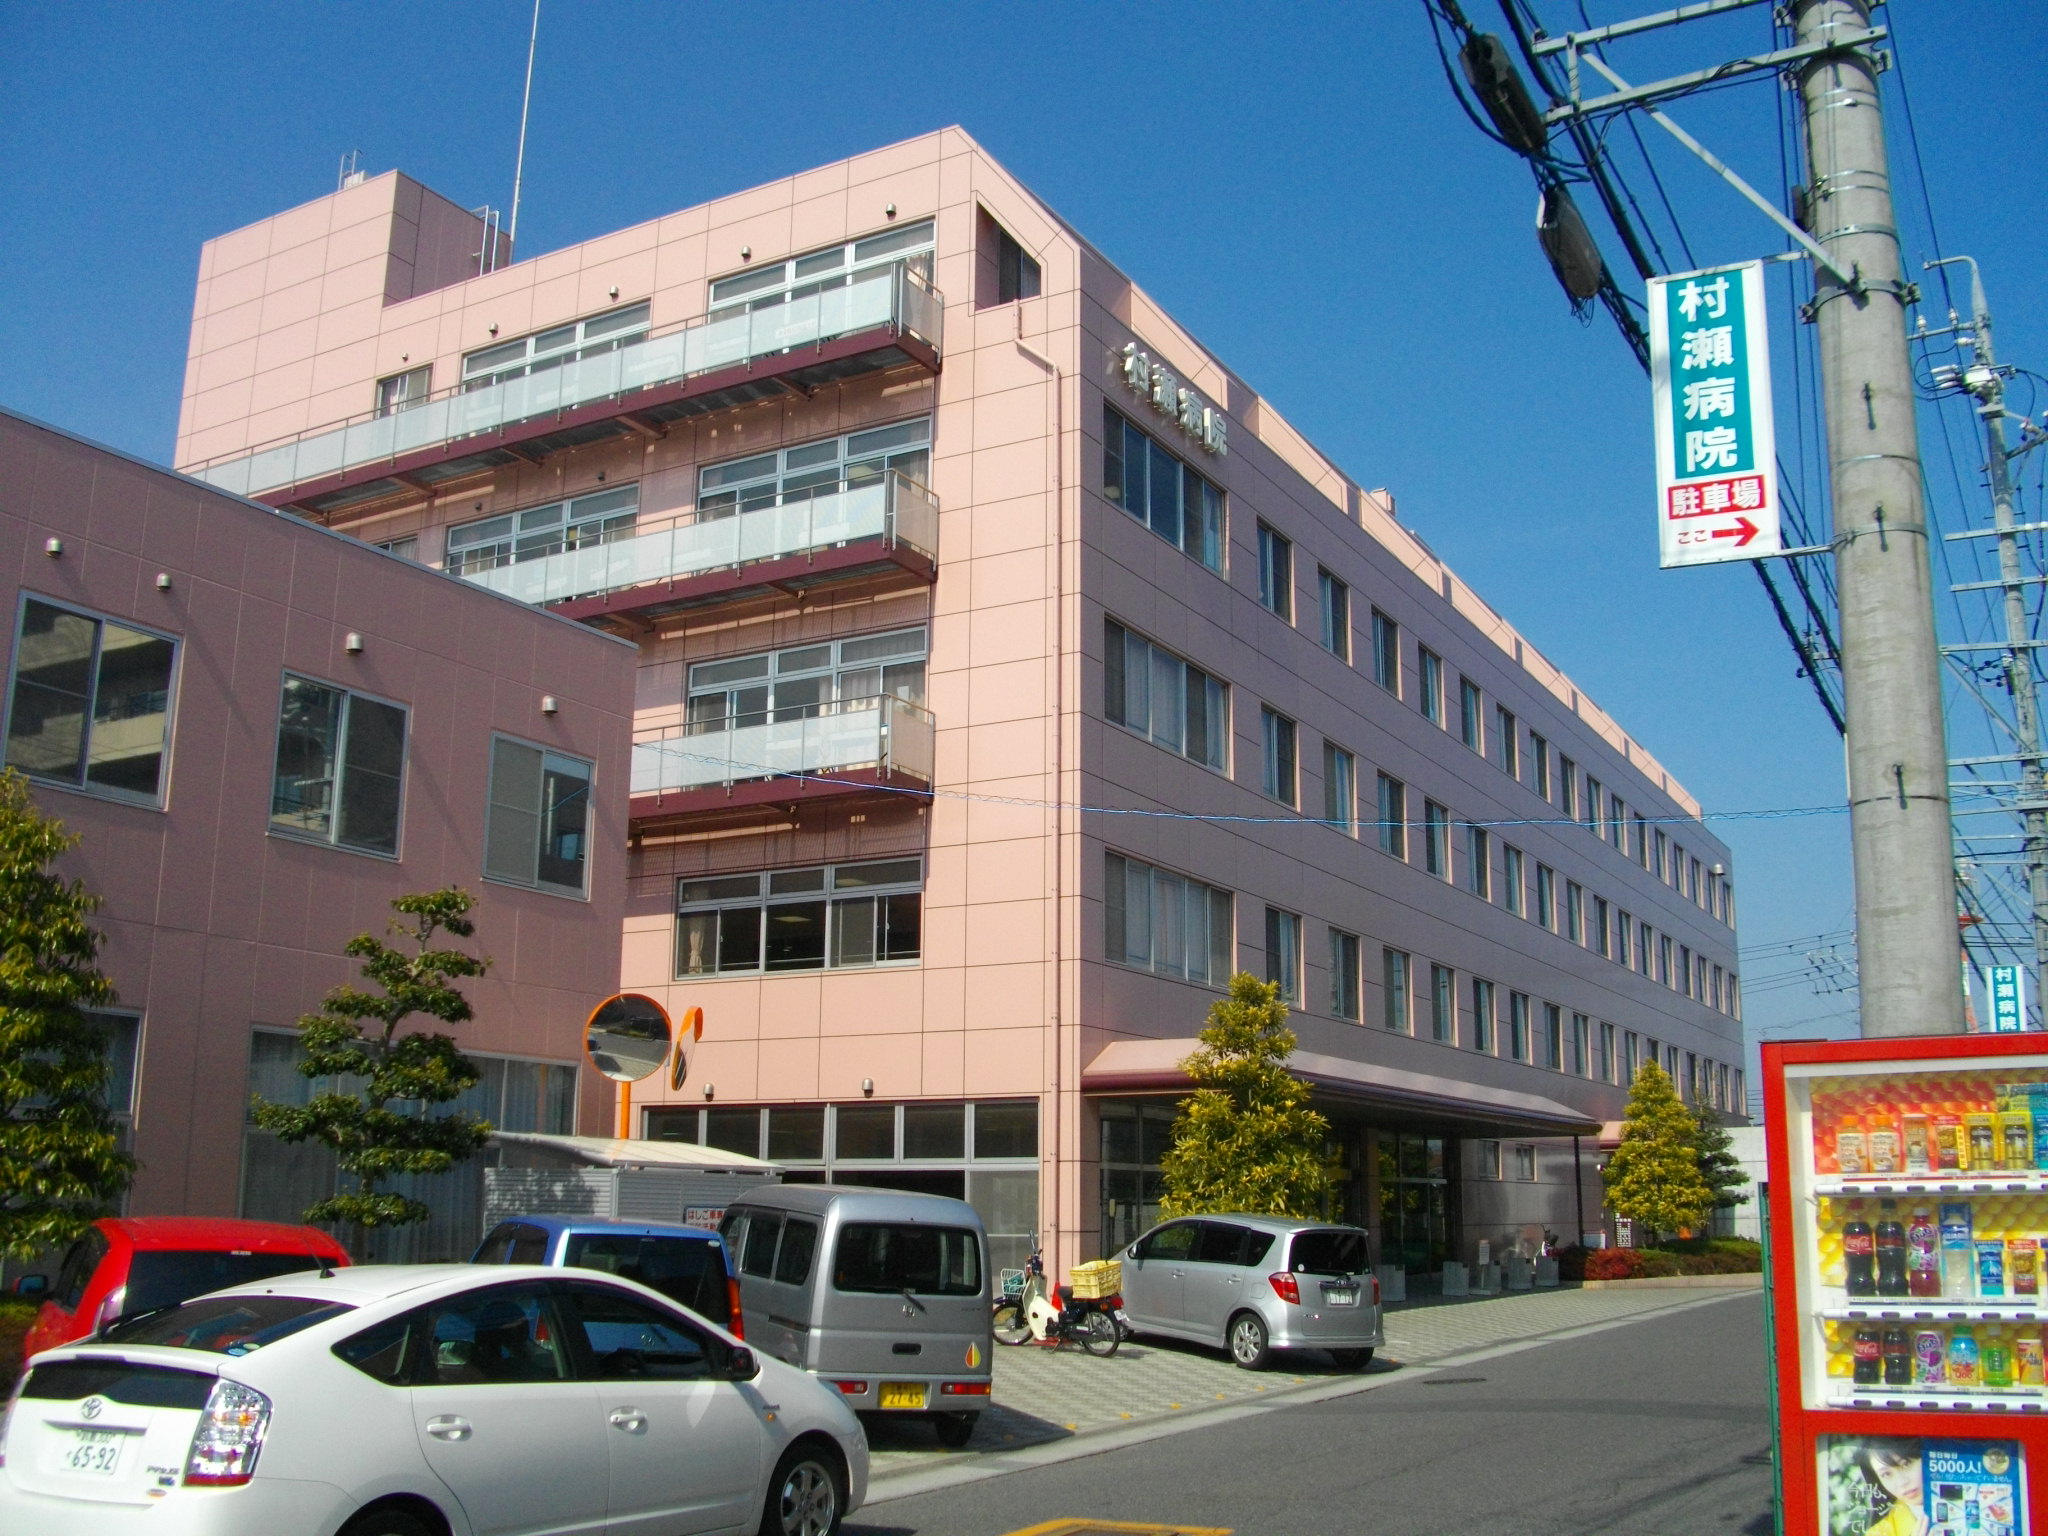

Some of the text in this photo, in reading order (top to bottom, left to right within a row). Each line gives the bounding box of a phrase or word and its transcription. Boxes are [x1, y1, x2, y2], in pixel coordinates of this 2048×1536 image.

[1677, 276, 1738, 473] 村瀬病院
[1672, 479, 1761, 516] 駐車場
[1677, 529, 1707, 545] ここ
